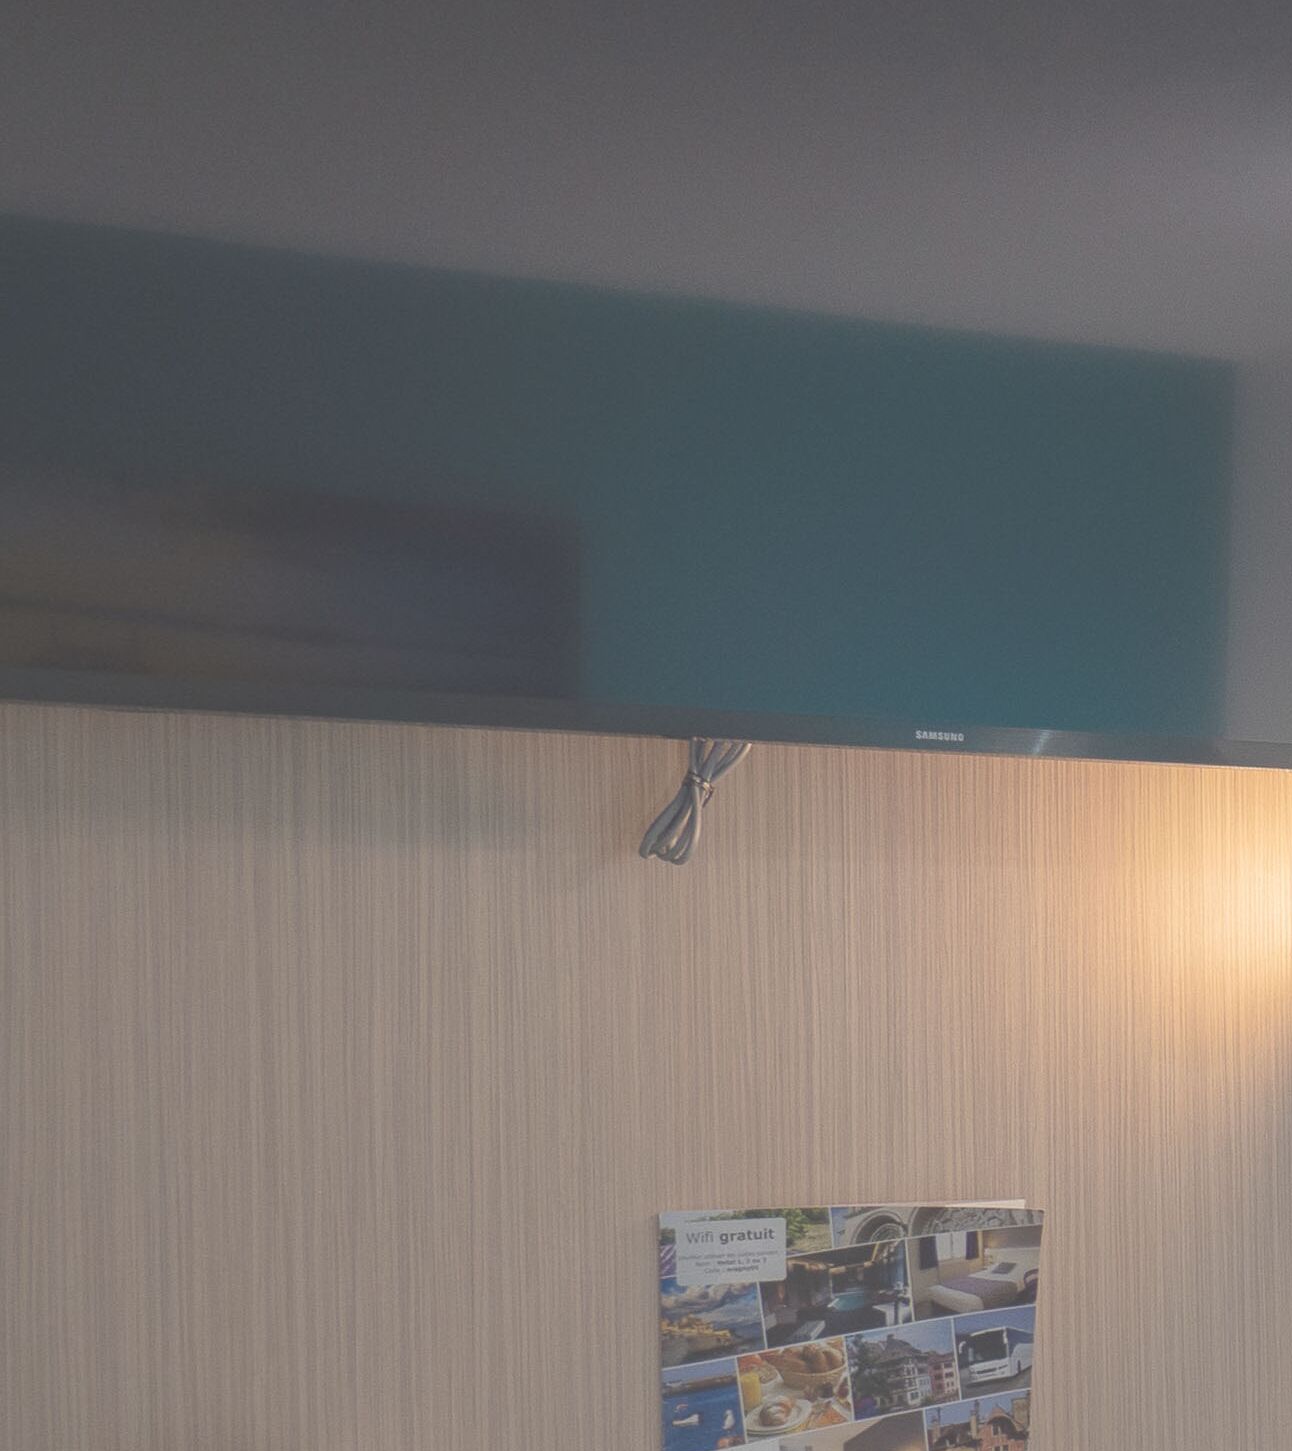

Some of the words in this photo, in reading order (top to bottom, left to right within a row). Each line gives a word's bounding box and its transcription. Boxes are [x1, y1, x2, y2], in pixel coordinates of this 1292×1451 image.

[915, 730, 965, 742] SAMSUNG
[686, 1231, 714, 1244] Wifi
[719, 1228, 775, 1245] gratuit
